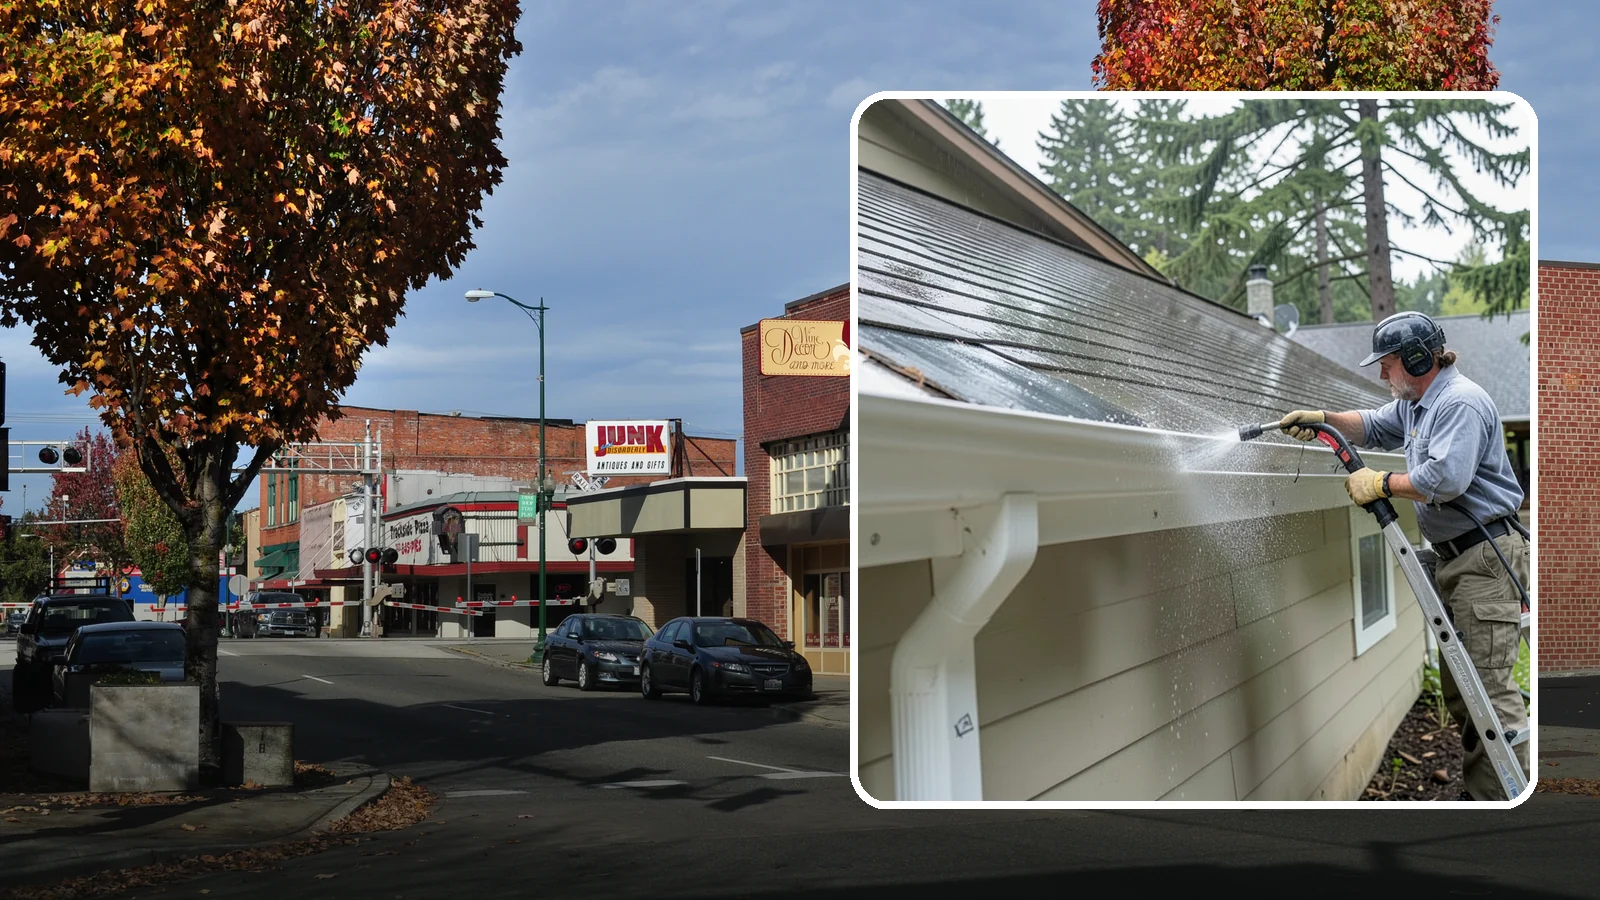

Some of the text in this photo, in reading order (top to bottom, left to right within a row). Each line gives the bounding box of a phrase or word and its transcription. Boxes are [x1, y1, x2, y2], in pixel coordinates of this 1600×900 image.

[765, 327, 831, 366] Decor
[595, 425, 664, 457] JUNK
[607, 446, 646, 455] DISORDERLY
[597, 460, 665, 470] ANTIQUES AND GIFTS
[573, 473, 589, 491] RAIL
[352, 498, 365, 511] CRO
[390, 519, 429, 540] Trackside Pizza
